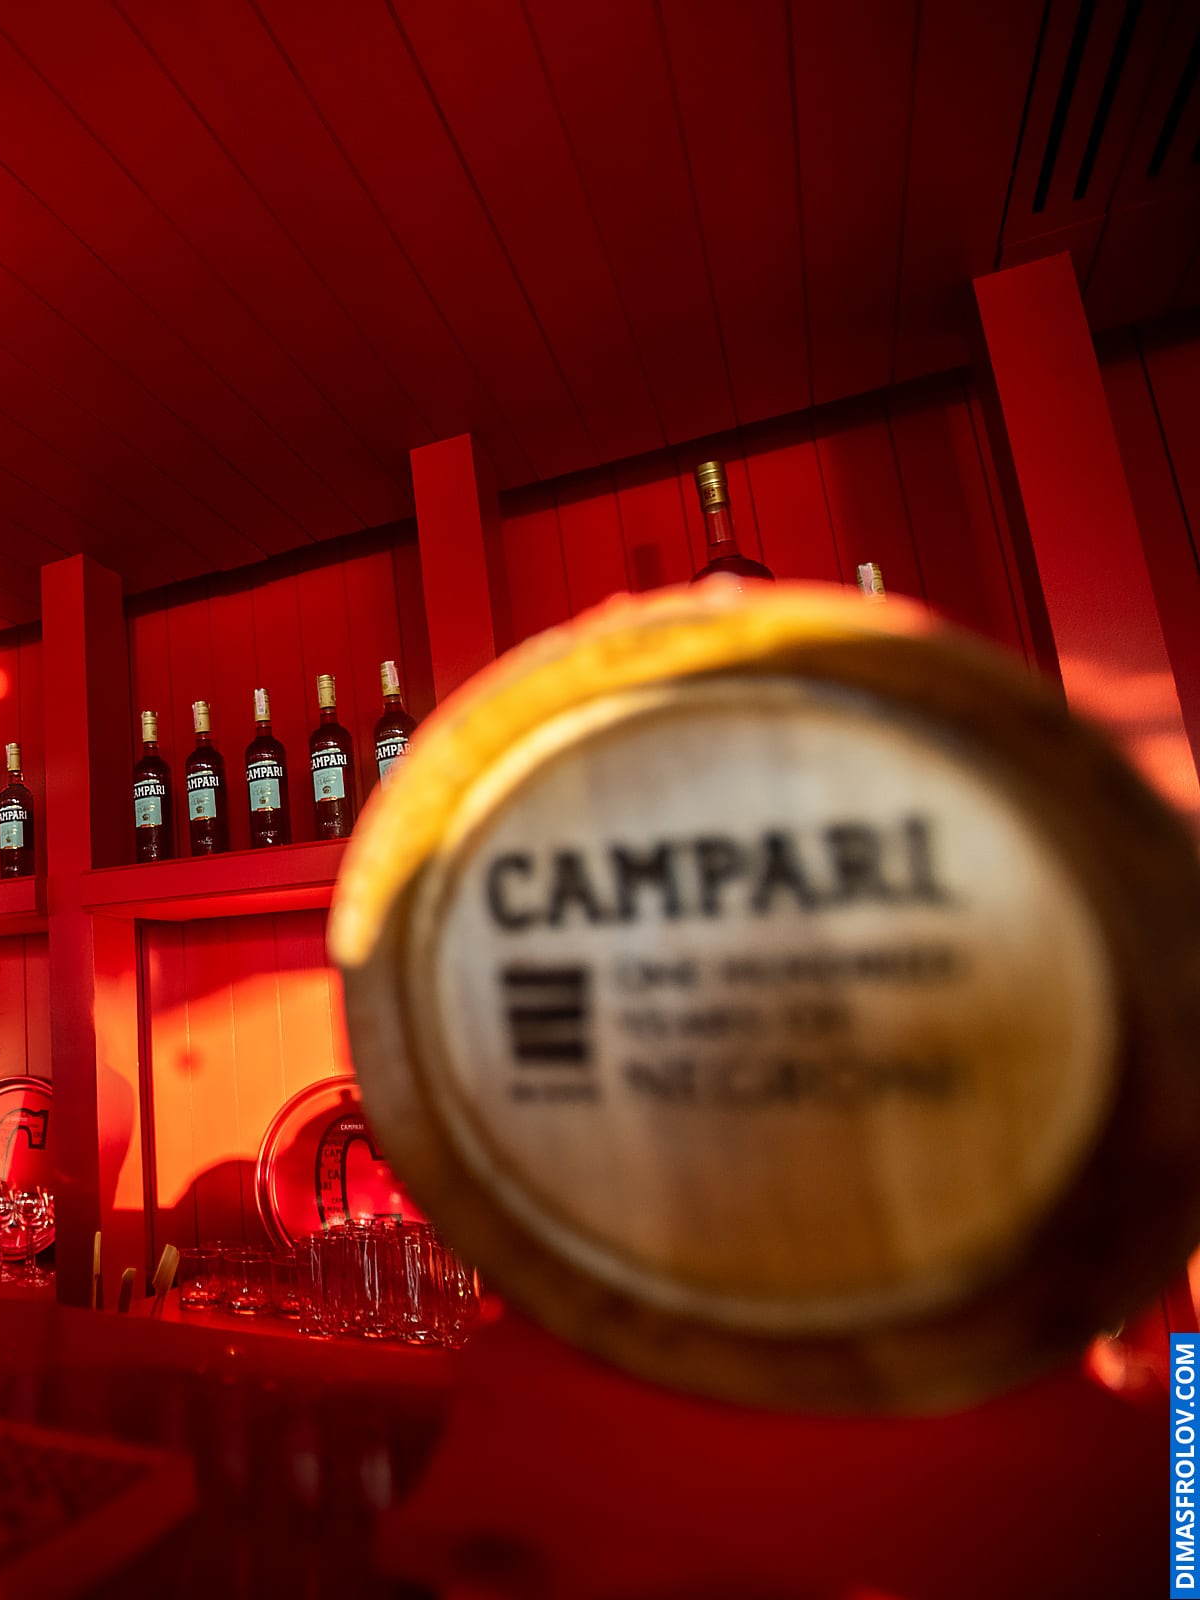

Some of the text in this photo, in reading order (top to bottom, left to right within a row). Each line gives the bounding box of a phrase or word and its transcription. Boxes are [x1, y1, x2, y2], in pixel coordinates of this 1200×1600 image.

[187, 776, 219, 791] AMPARI
[134, 785, 166, 799] AMPARI
[484, 814, 956, 930] CAMPARI
